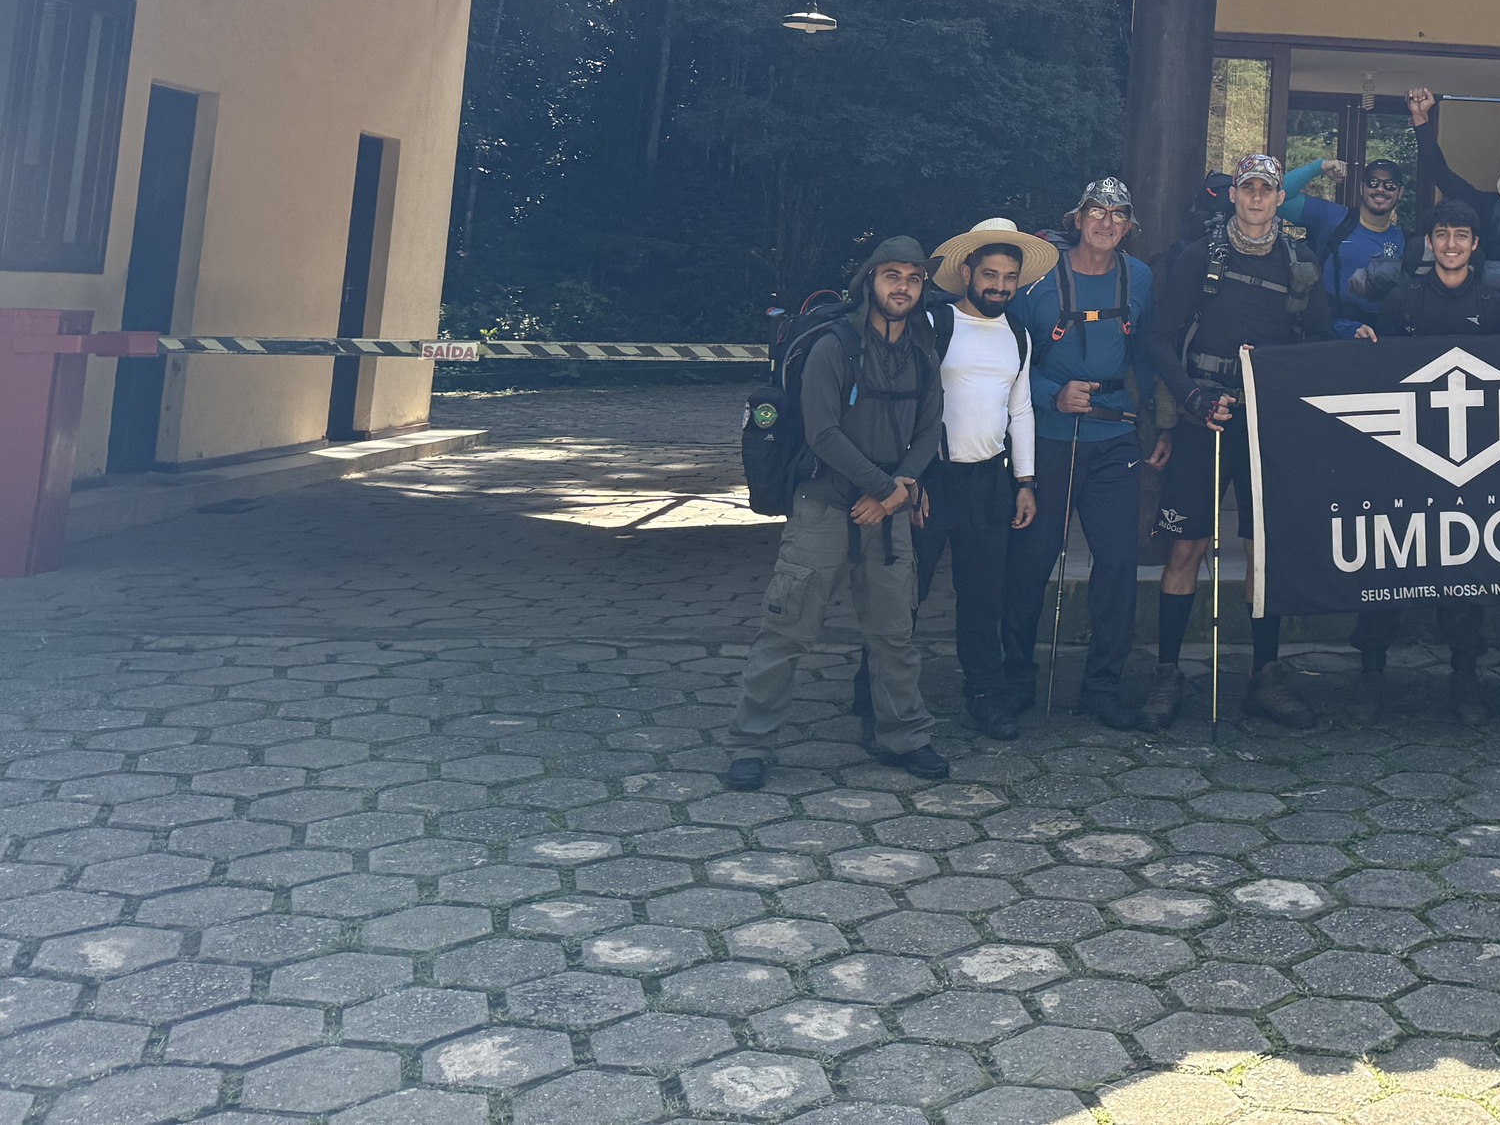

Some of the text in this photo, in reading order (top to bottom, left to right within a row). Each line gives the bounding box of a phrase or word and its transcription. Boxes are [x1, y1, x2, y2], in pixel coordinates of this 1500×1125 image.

[422, 343, 475, 359] SAÍDA
[1361, 589, 1391, 602] SEUS
[1393, 585, 1440, 600] LIMITES,
[1443, 584, 1488, 597] NOSSA
